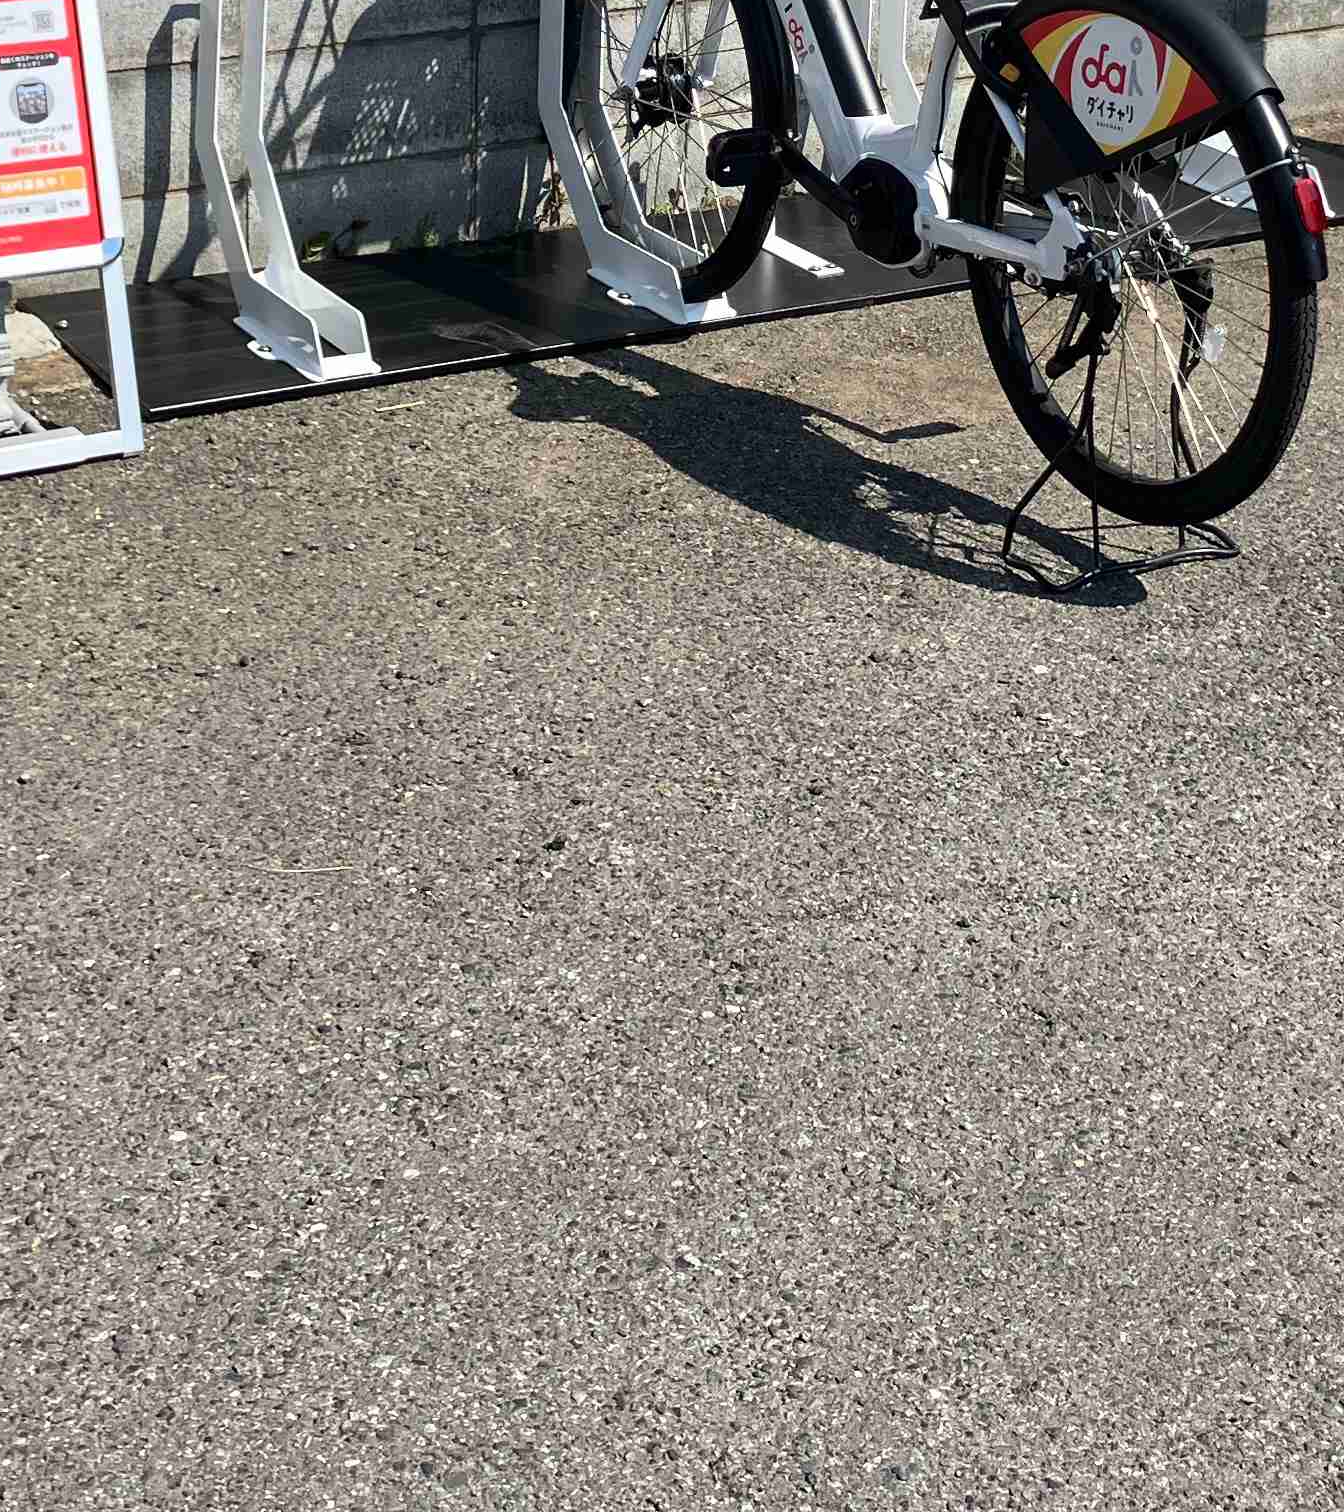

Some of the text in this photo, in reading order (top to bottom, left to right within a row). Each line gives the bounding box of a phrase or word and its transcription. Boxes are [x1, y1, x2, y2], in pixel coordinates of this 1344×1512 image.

[1081, 35, 1143, 97] dai
[1086, 96, 1135, 124] ダイチャリ
